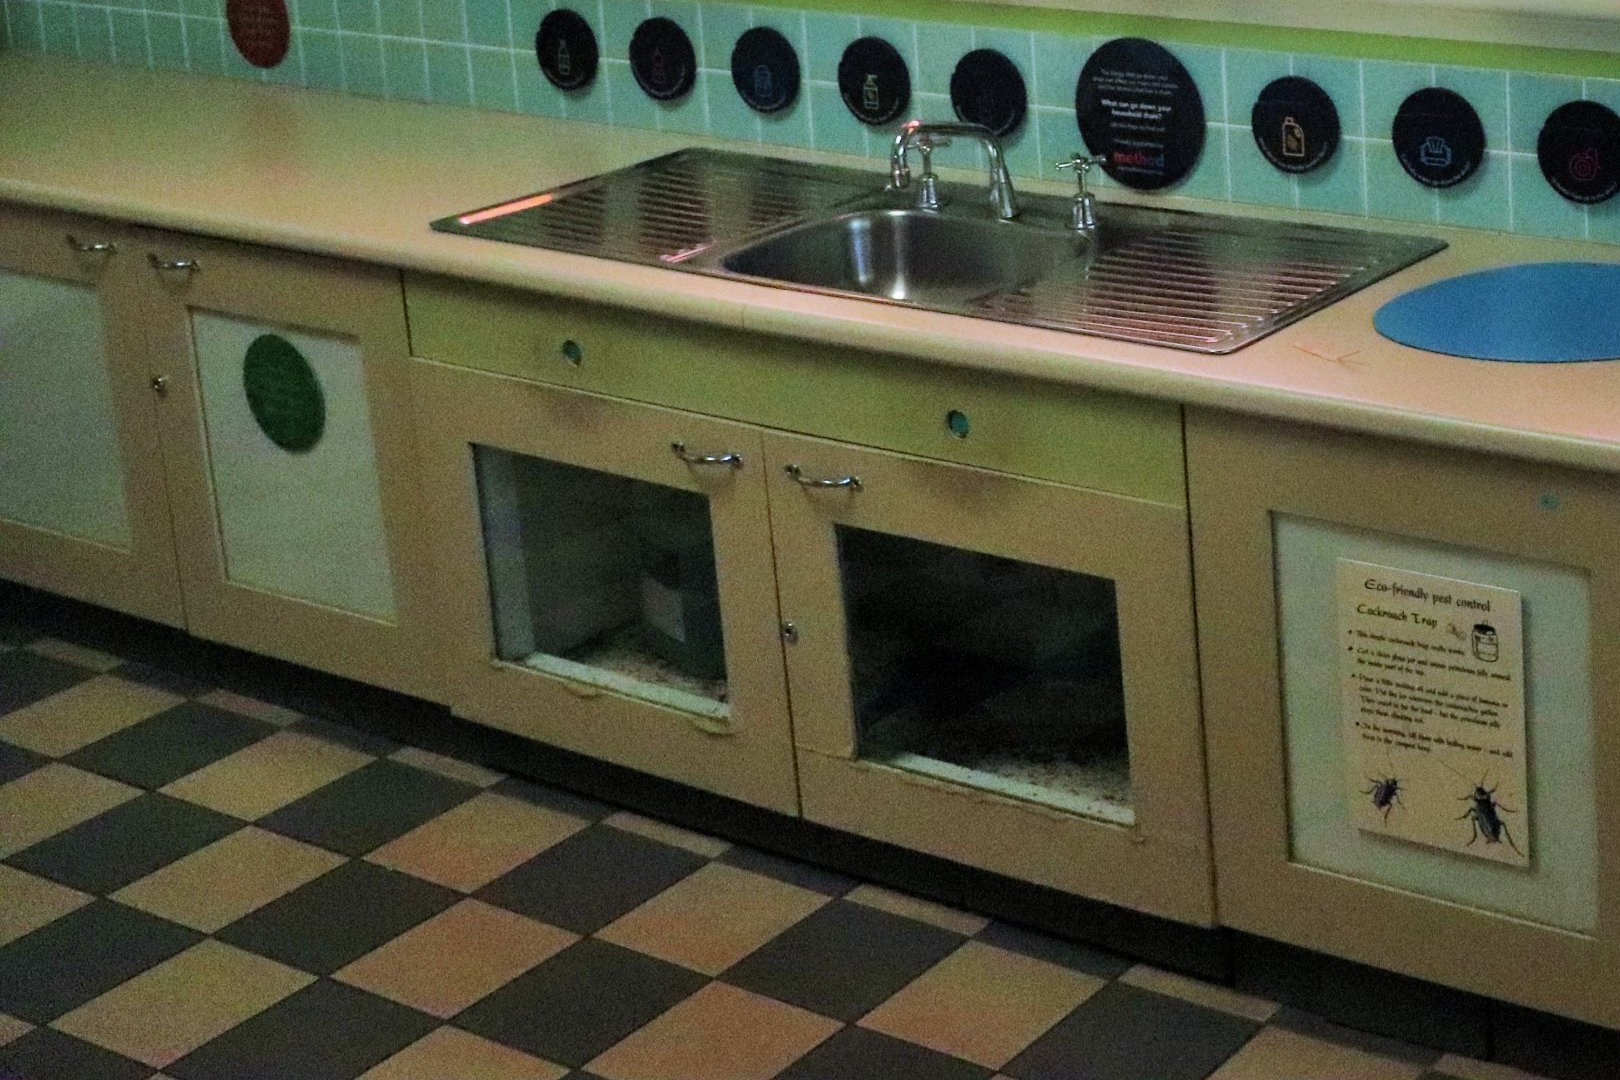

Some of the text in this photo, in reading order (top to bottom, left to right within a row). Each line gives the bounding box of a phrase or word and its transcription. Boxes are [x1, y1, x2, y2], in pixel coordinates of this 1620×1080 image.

[1364, 578, 1491, 612] Eco-friendly pest control
[1356, 603, 1438, 629] Cockroach Trap
